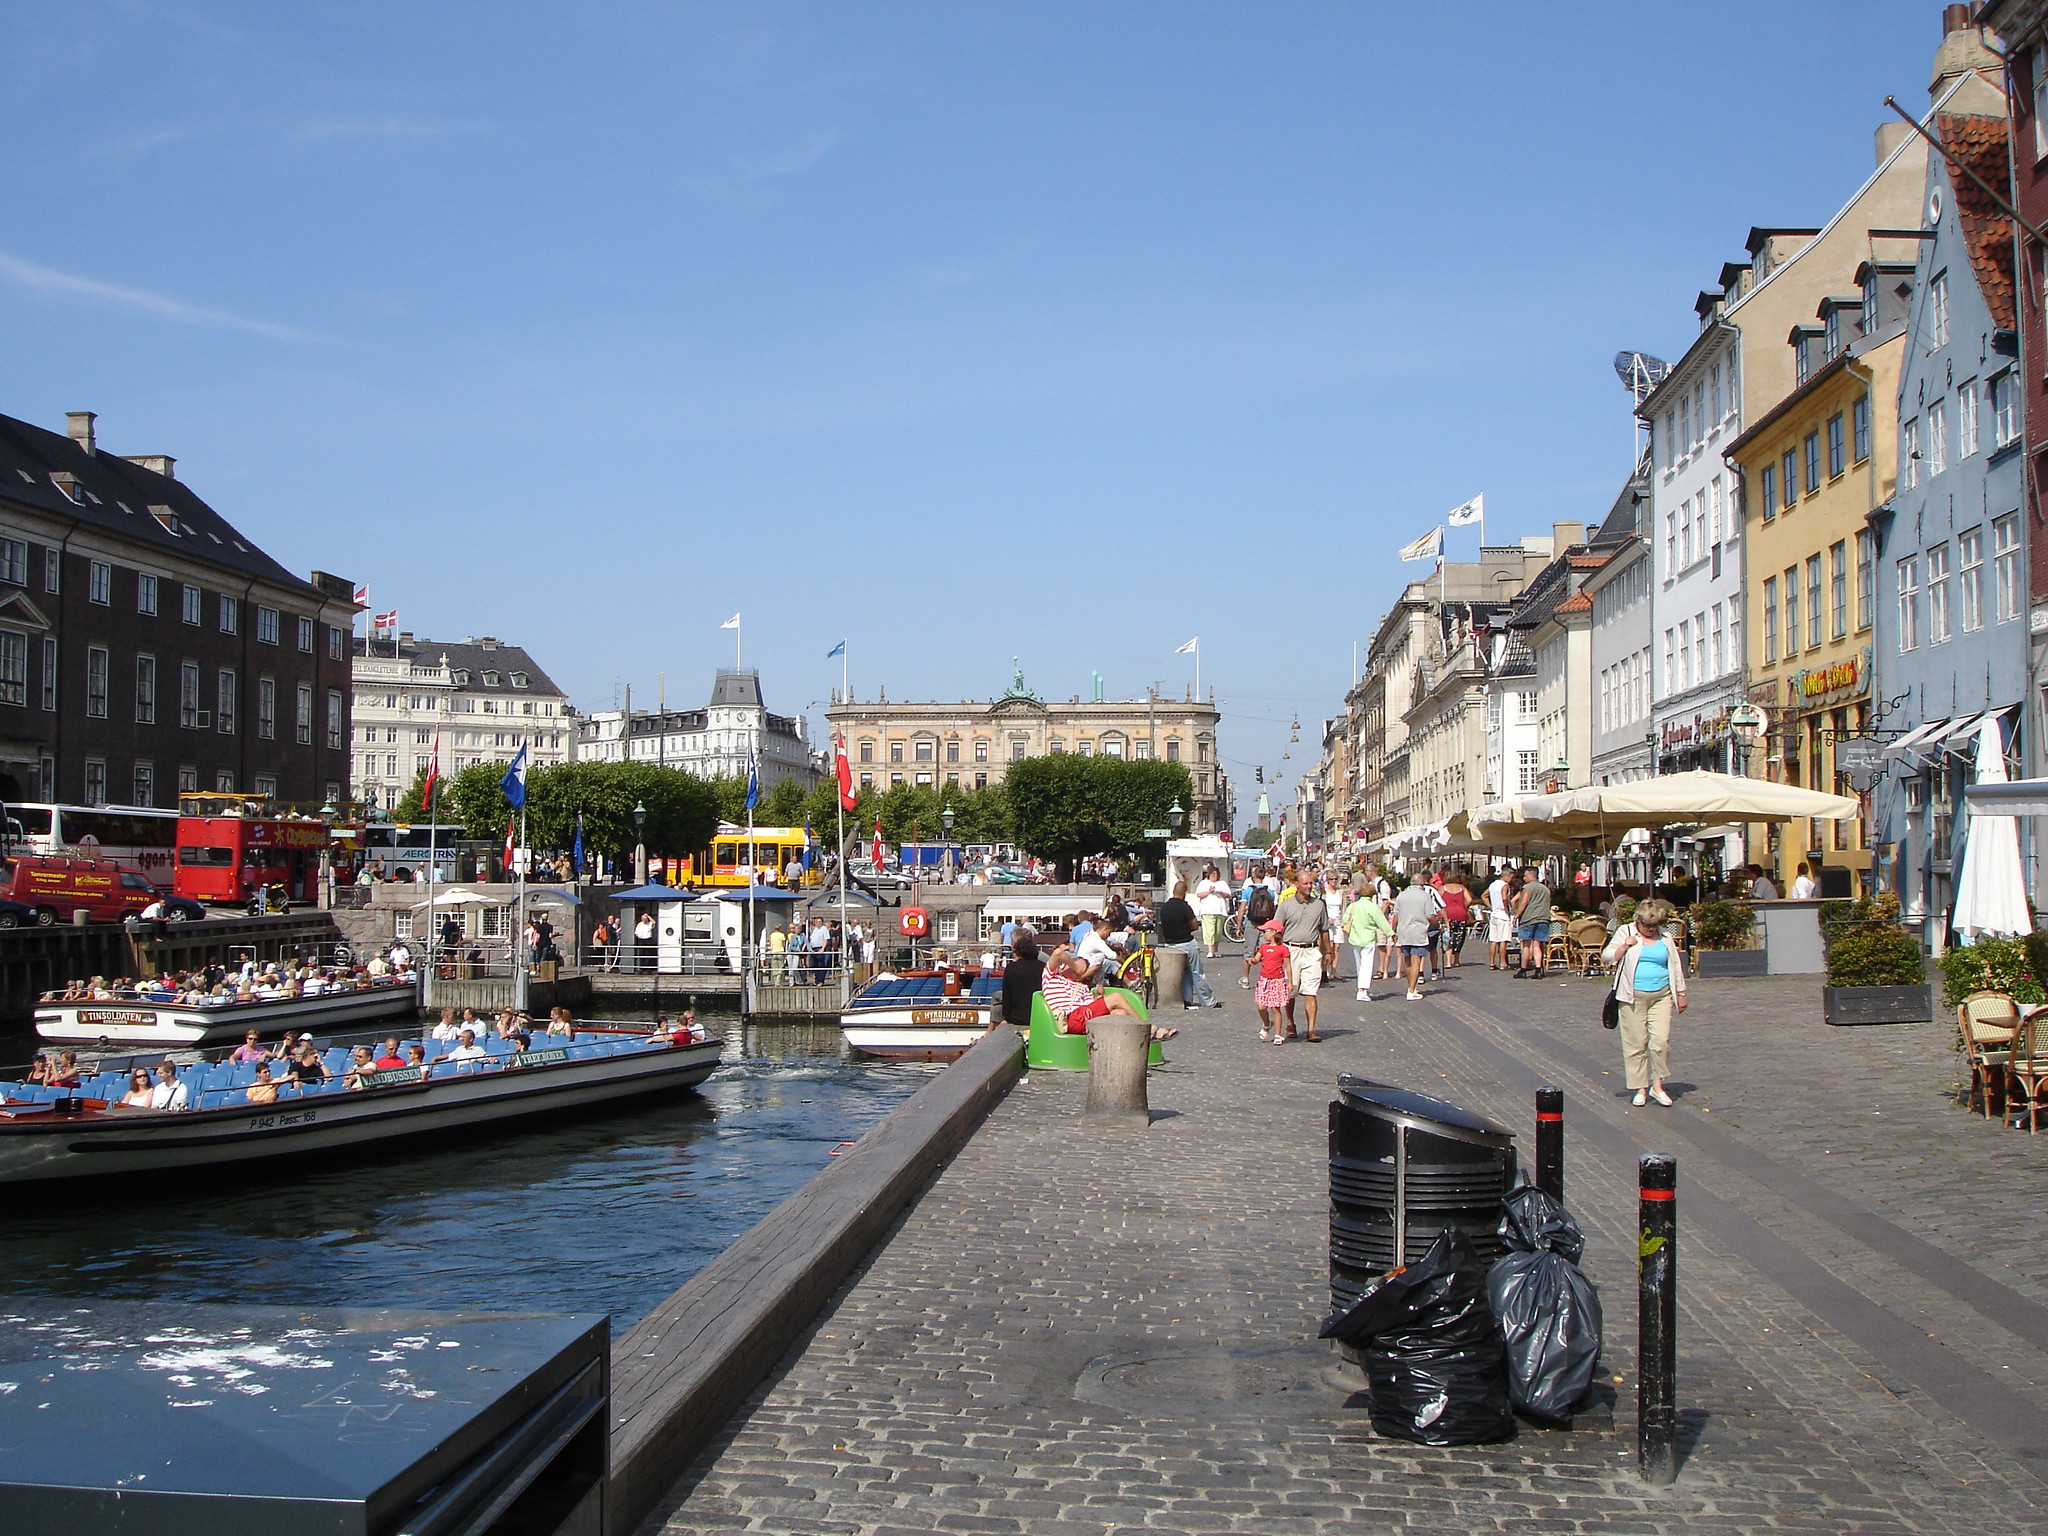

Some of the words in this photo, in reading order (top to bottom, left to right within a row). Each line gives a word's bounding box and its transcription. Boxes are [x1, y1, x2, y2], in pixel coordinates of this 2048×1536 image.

[138, 849, 175, 871] egon's
[88, 1012, 142, 1022] TINSOLDATEN
[924, 1011, 966, 1019] HYRDINDEN
[362, 1069, 421, 1086] VANDBUSSEN
[250, 1119, 257, 1130] P
[258, 1117, 275, 1128] 942
[303, 1110, 317, 1122] 168
